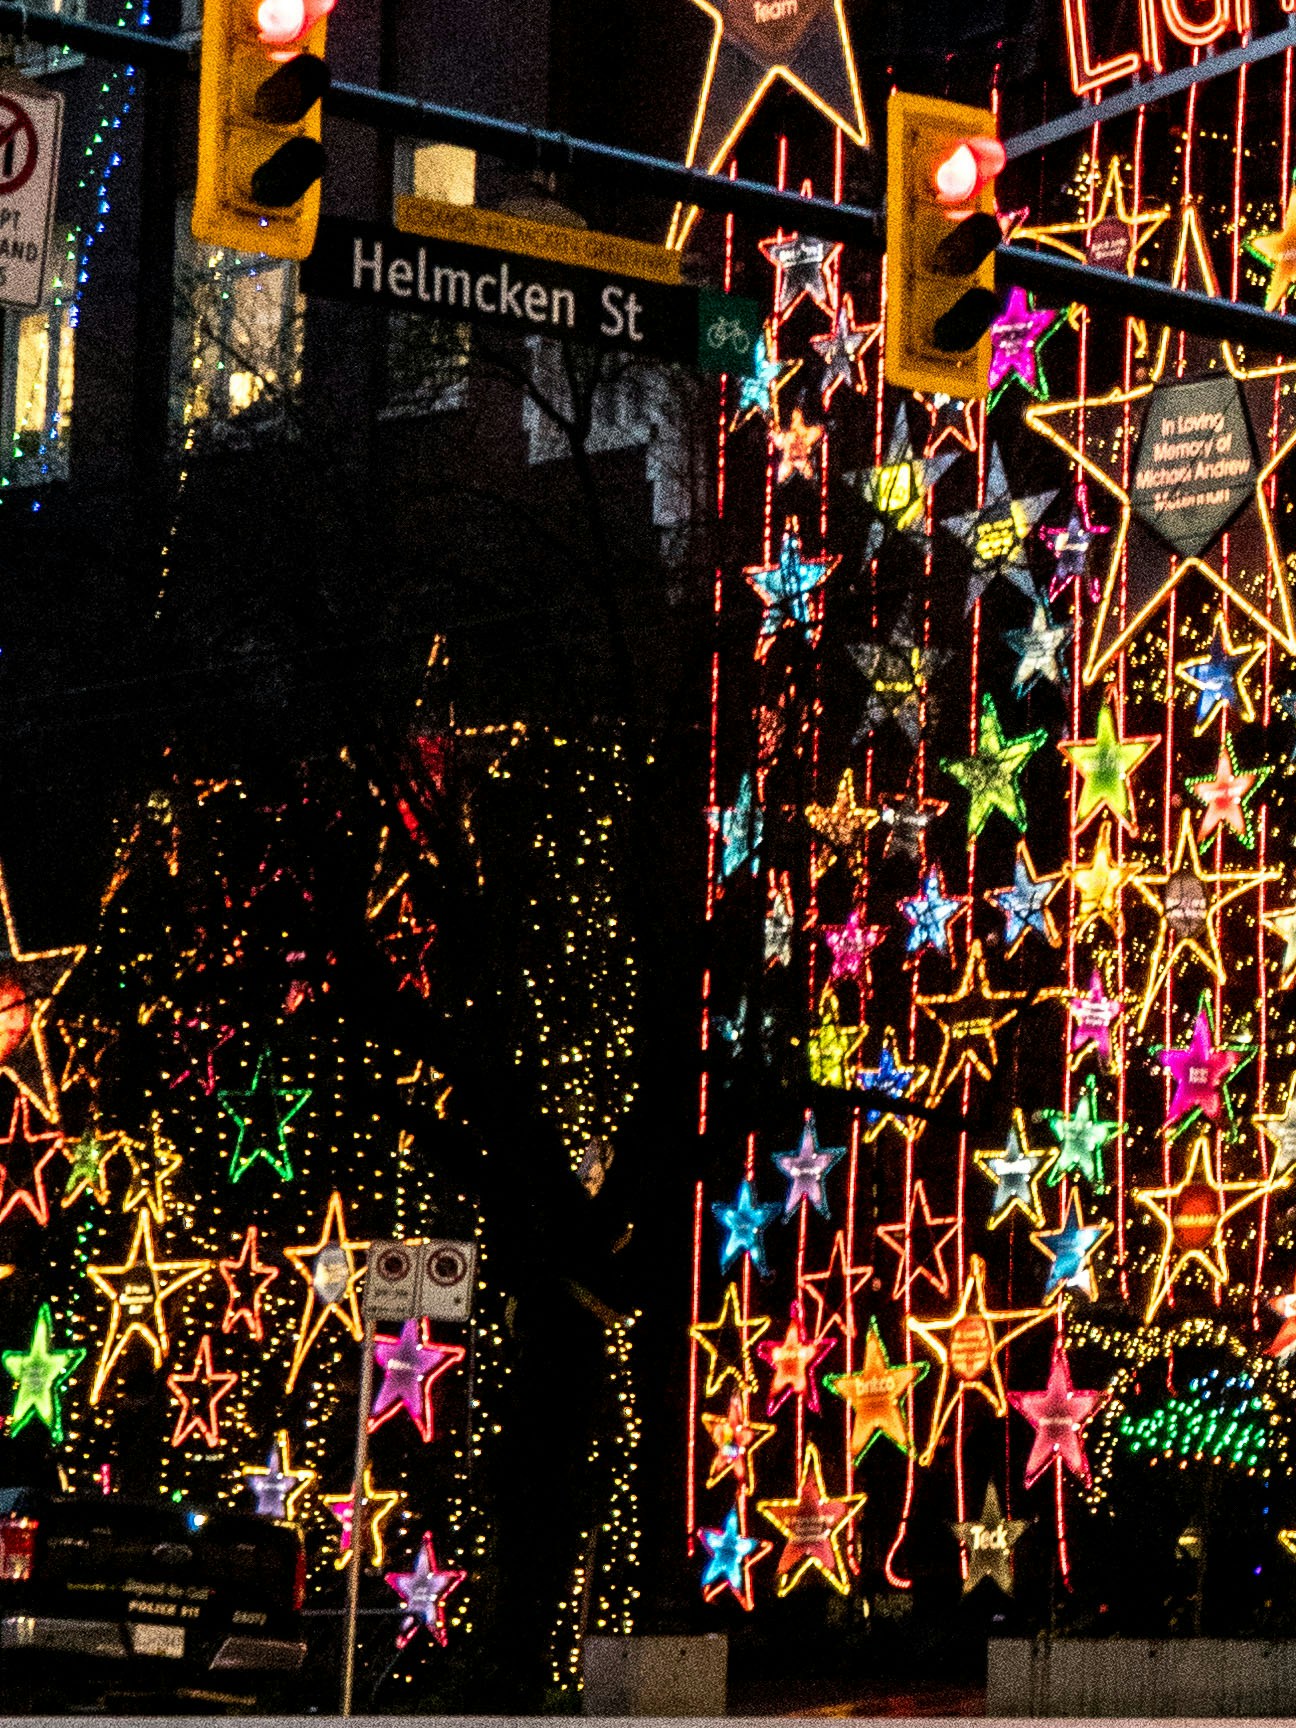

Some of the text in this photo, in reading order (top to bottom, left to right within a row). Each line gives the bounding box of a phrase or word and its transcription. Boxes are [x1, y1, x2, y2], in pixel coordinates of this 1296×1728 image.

[353, 238, 644, 342] Helmcken St
[1178, 412, 1225, 433] Loving
[970, 1521, 1008, 1551] Teck
